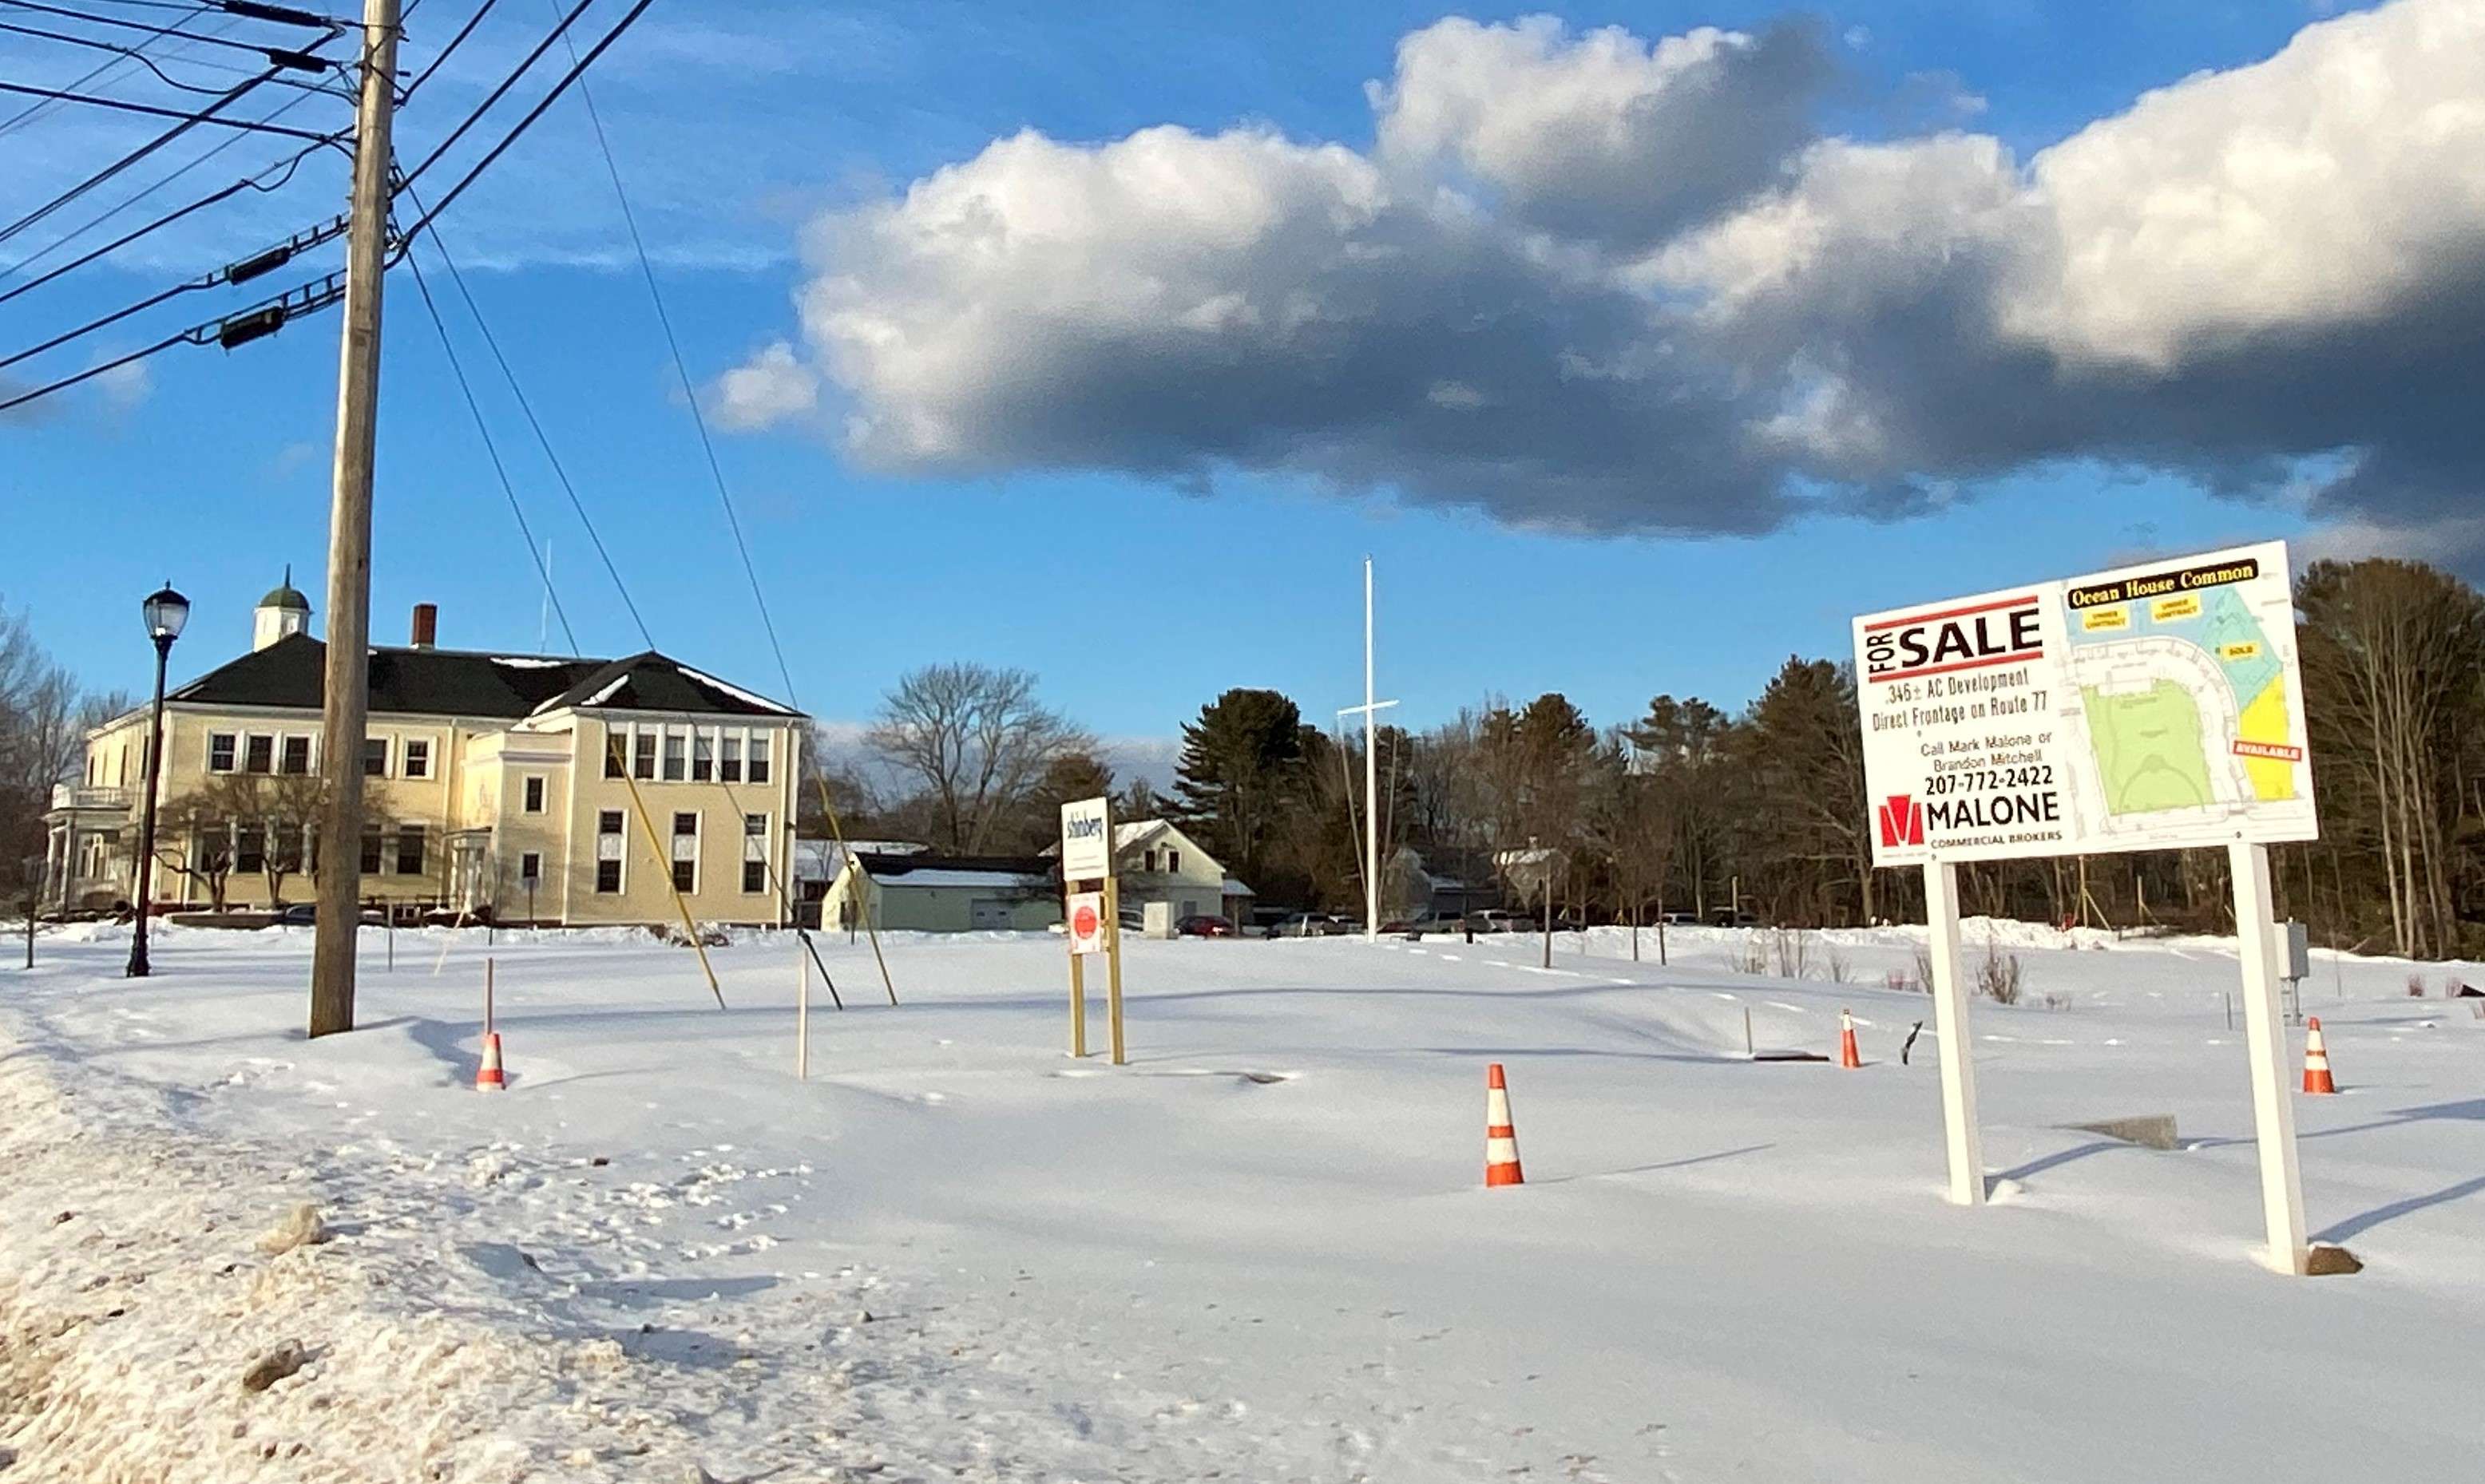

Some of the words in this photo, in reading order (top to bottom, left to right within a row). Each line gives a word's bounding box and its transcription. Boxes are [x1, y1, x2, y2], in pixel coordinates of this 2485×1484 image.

[2072, 586, 2119, 607] Ocean
[2127, 577, 2174, 598] House
[2181, 565, 2253, 588] Common
[1867, 632, 1896, 673] FOR
[1900, 608, 2043, 667] SALE
[1928, 679, 1944, 698] AC
[1949, 667, 2029, 696] Development
[1873, 709, 1908, 730] Direct
[1912, 704, 1965, 727] Frontage
[1972, 702, 1985, 717] on
[1991, 696, 2027, 714] Route
[2032, 691, 2048, 710] 77
[1921, 742, 1944, 757] Call
[1949, 738, 1979, 753] Mark
[1986, 734, 2032, 749] Malone
[2039, 733, 2052, 743] or
[1934, 756, 1986, 772] Brandon
[1992, 749, 2043, 765] Mitchell
[2237, 744, 2299, 759] AVAILABLE
[1925, 766, 2053, 795] 207-772-2422
[1927, 792, 2059, 830] MALONE
[1931, 835, 2005, 849] COMMERCIAL
[2009, 830, 2063, 843] BROKERS
